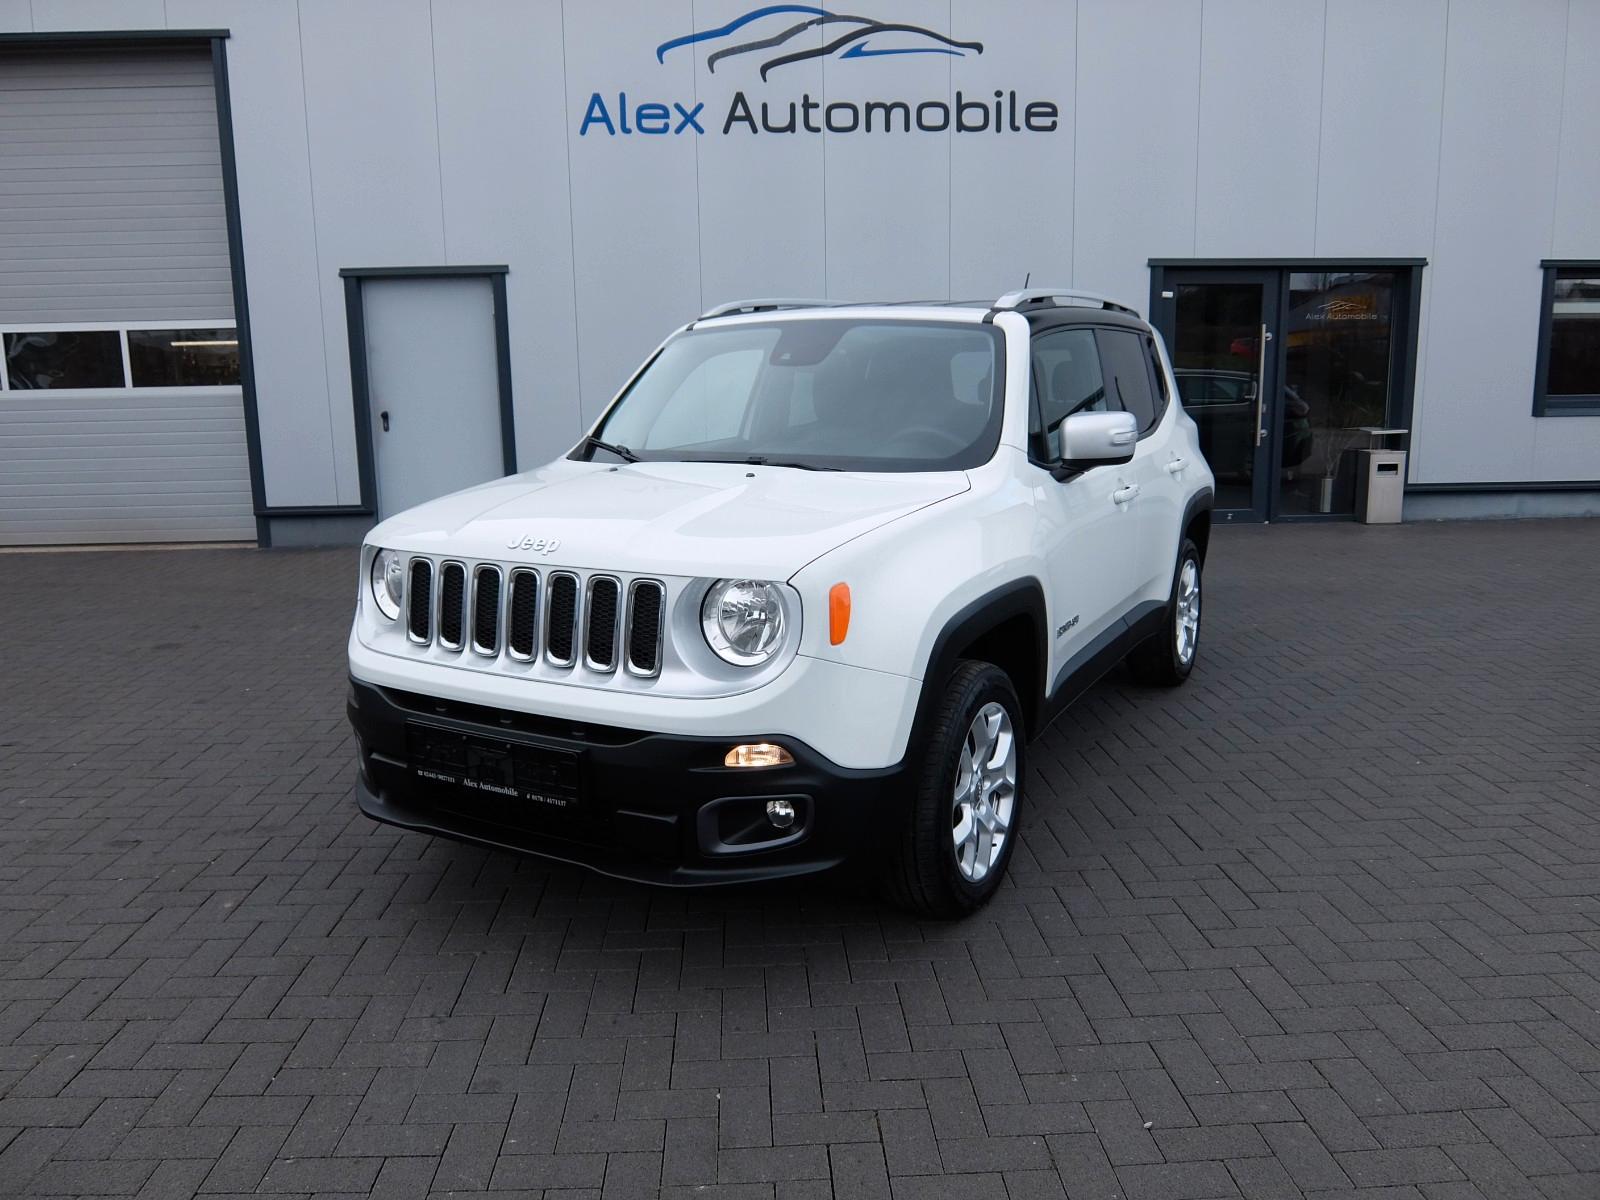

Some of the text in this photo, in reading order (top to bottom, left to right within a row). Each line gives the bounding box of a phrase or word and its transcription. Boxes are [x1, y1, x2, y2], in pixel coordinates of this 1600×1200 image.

[579, 89, 1060, 136] Alex Automobile
[1305, 312, 1377, 320] Alex Automobile
[505, 533, 562, 556] Jeep
[463, 778, 518, 796] Alex Automobile
